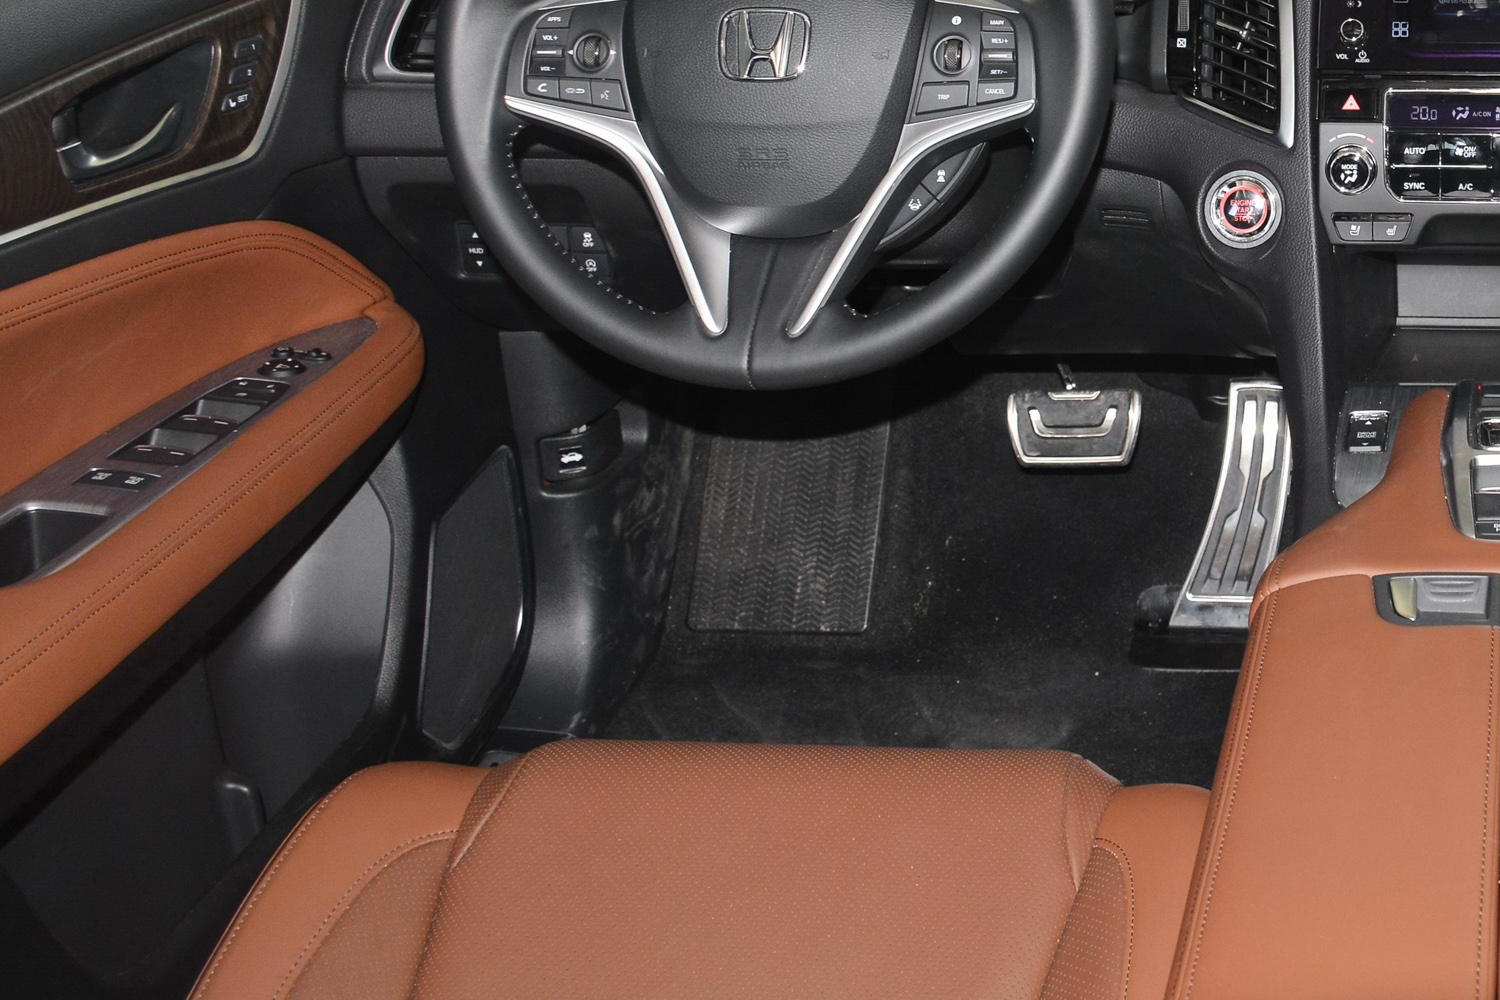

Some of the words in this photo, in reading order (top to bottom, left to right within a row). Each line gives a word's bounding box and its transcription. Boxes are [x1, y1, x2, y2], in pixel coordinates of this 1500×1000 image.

[237, 93, 249, 103] SET
[1410, 105, 1438, 121] 20.0
[1403, 147, 1425, 155] AUTO
[1403, 182, 1425, 190] SYNC
[1458, 183, 1474, 191] A/C
